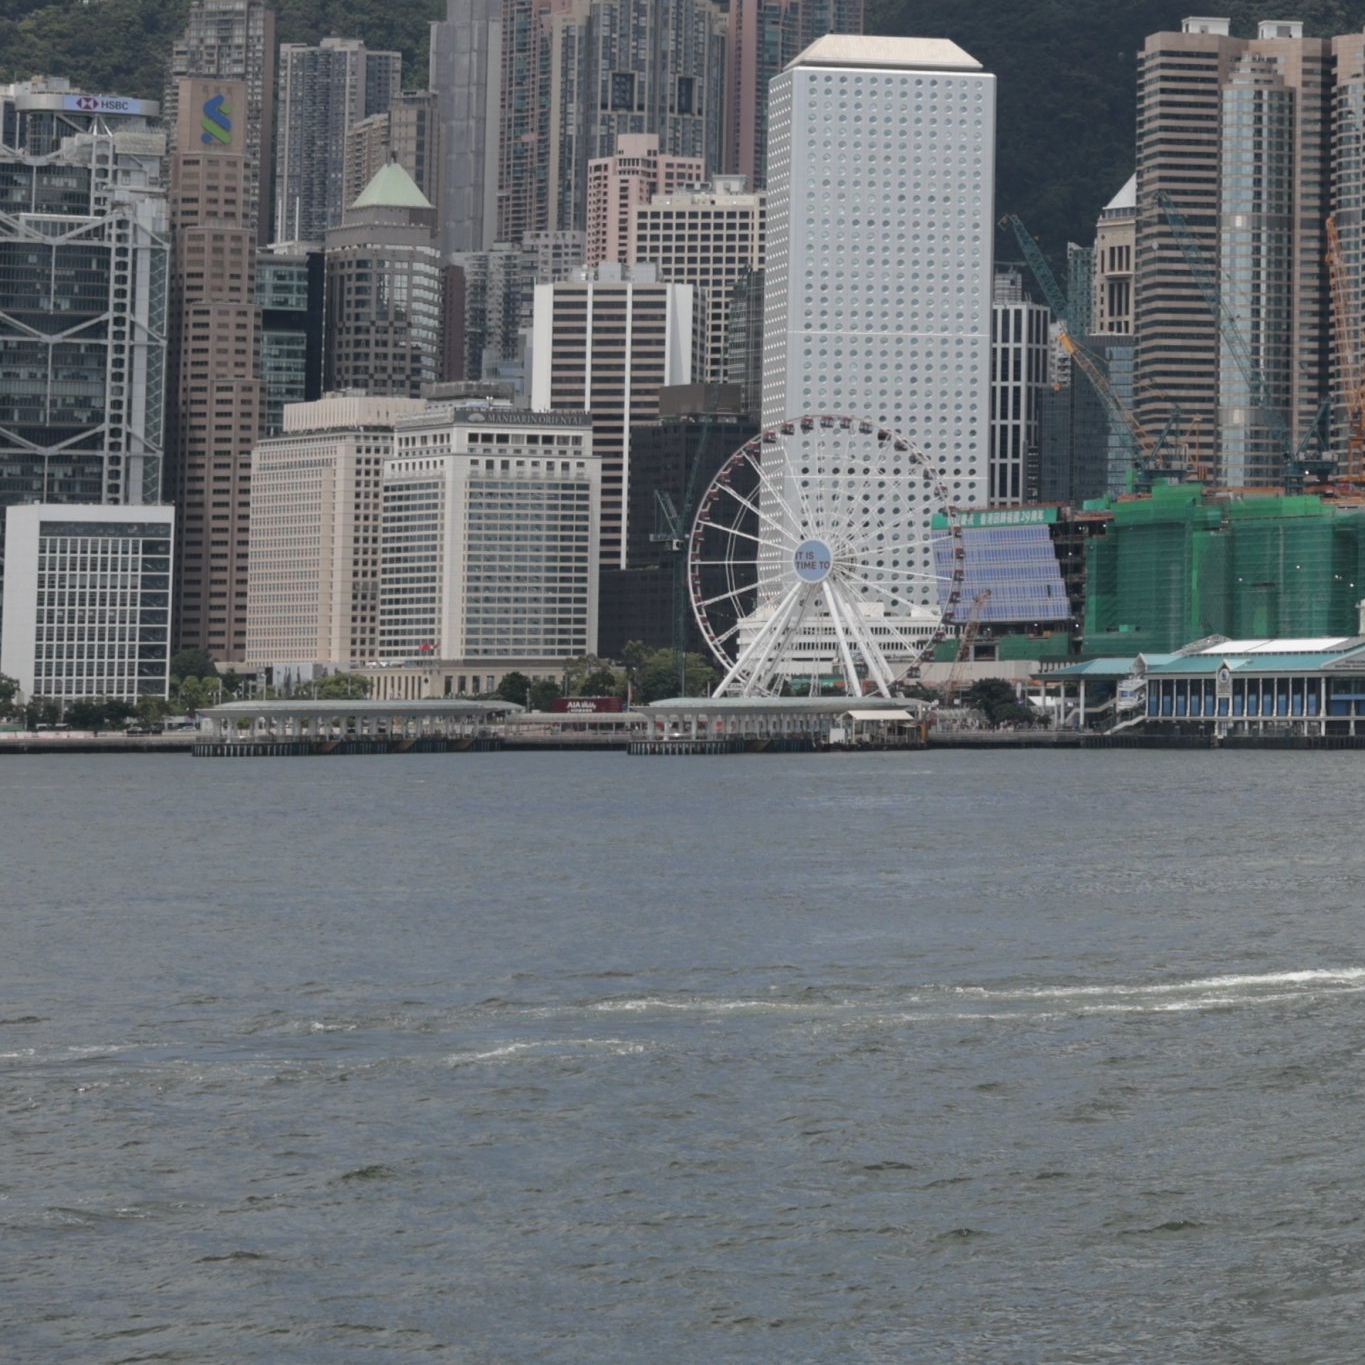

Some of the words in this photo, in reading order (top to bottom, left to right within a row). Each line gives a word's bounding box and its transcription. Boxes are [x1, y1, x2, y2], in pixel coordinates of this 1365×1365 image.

[101, 100, 129, 111] HSBC
[488, 413, 538, 424] MANDARIN
[540, 415, 583, 426] ORIENTAL
[795, 551, 803, 560] IT
[806, 551, 815, 560] IS
[795, 561, 816, 570] TIME
[819, 561, 830, 570] TO
[566, 701, 581, 709] AIA
